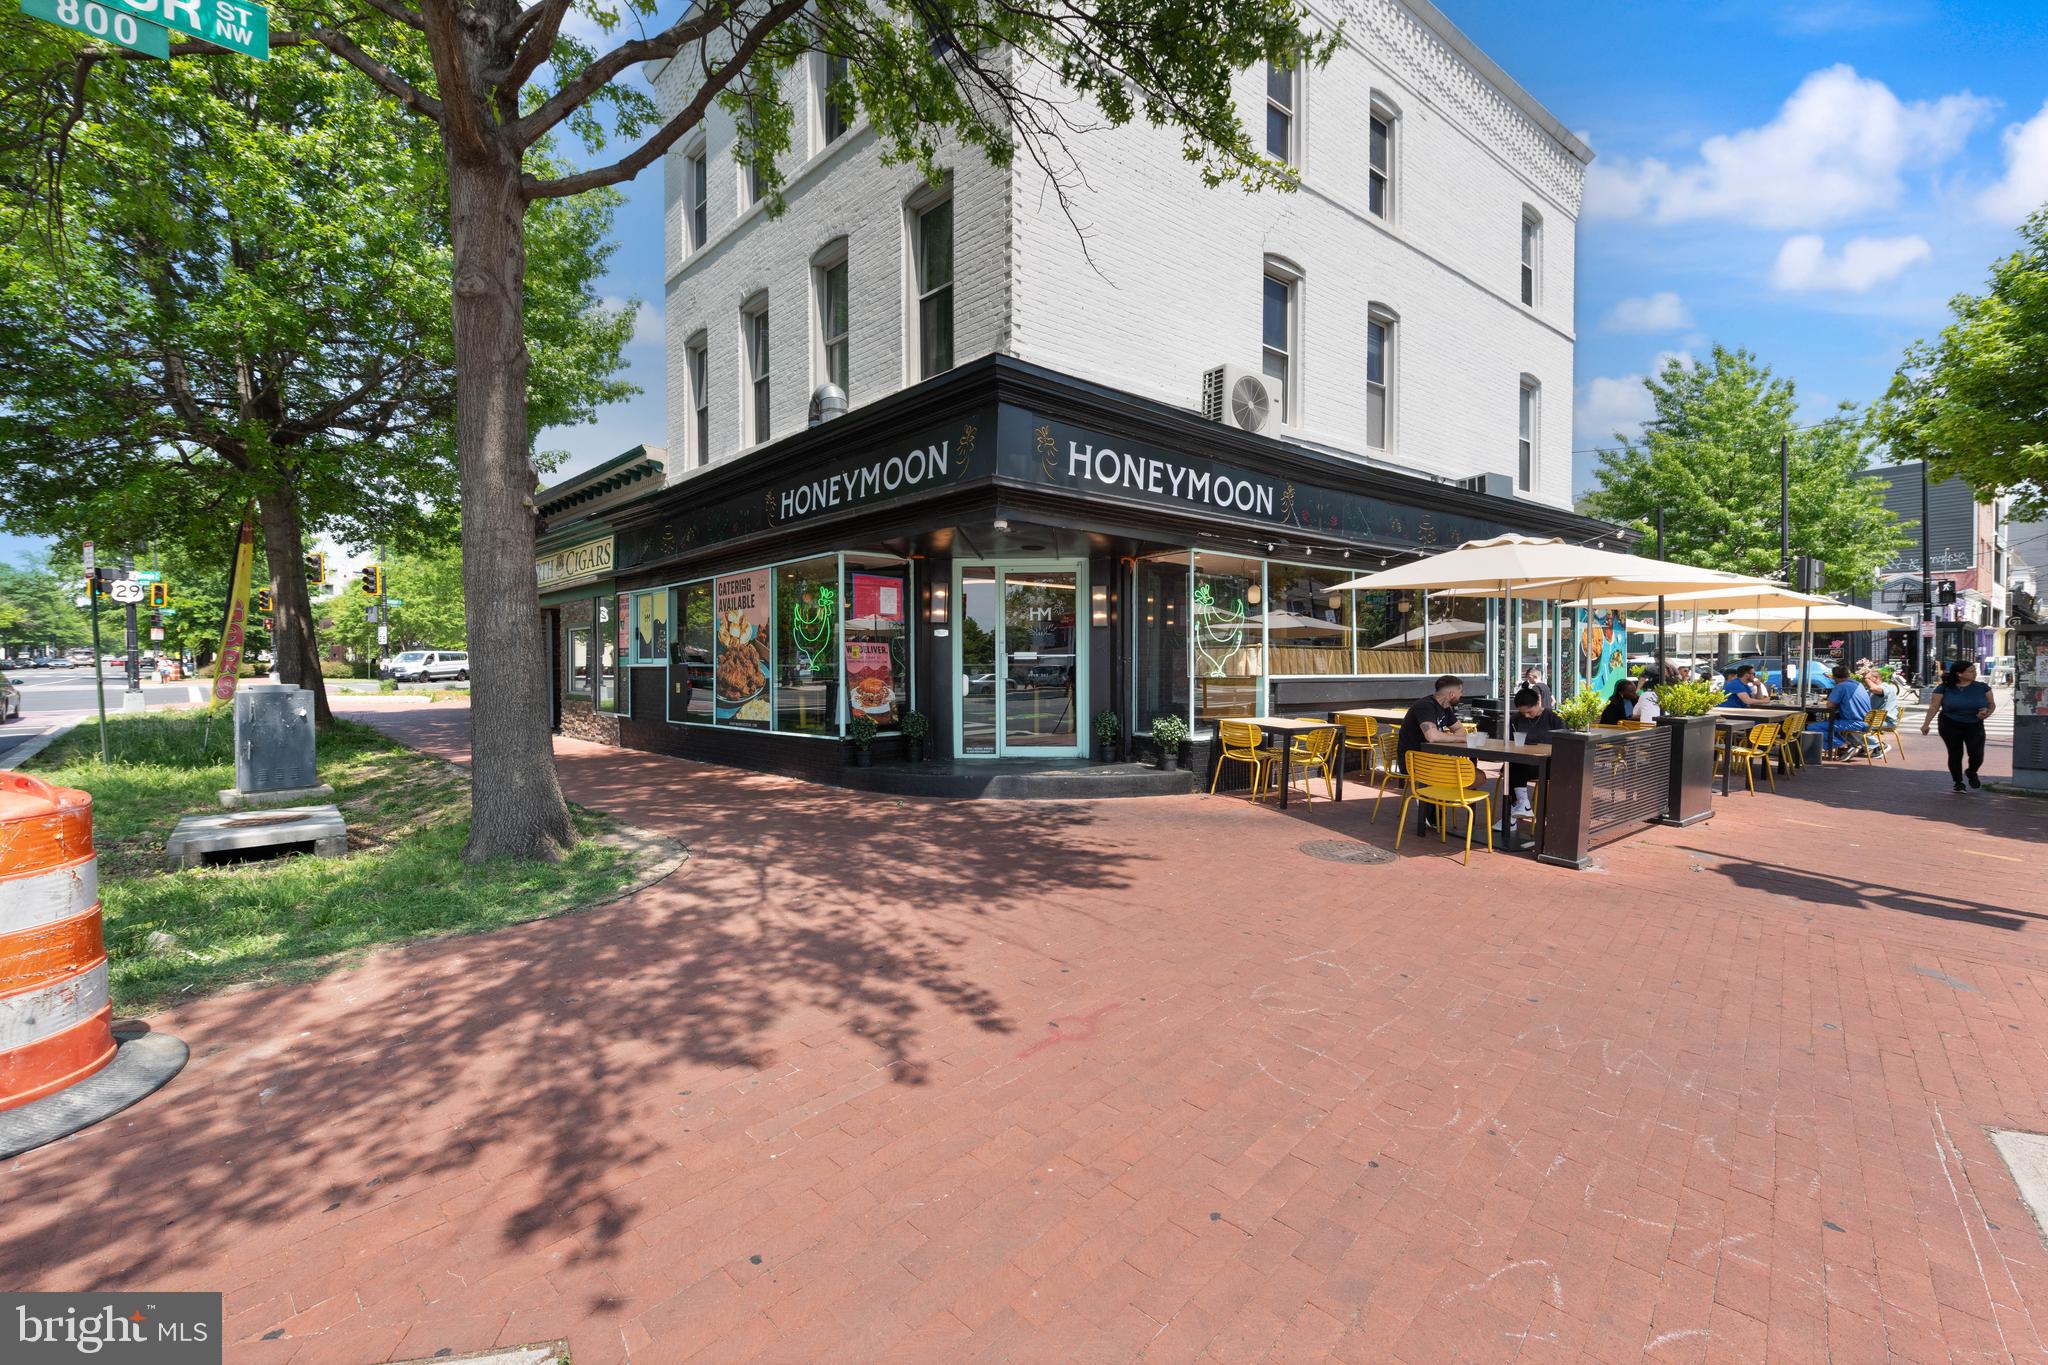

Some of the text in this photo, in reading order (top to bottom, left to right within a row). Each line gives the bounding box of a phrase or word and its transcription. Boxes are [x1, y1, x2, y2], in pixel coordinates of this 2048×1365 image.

[56, 0, 138, 45] 800
[216, 1, 253, 27] ST
[216, 19, 254, 46] NW
[780, 440, 949, 520] HONEYMOON
[1067, 441, 1274, 515] HONEYMOON
[566, 543, 611, 576] CIGARS
[116, 585, 140, 597] 29
[718, 577, 752, 597] CATERING
[718, 594, 755, 612] AVAILABLE
[1029, 607, 1052, 621] HM
